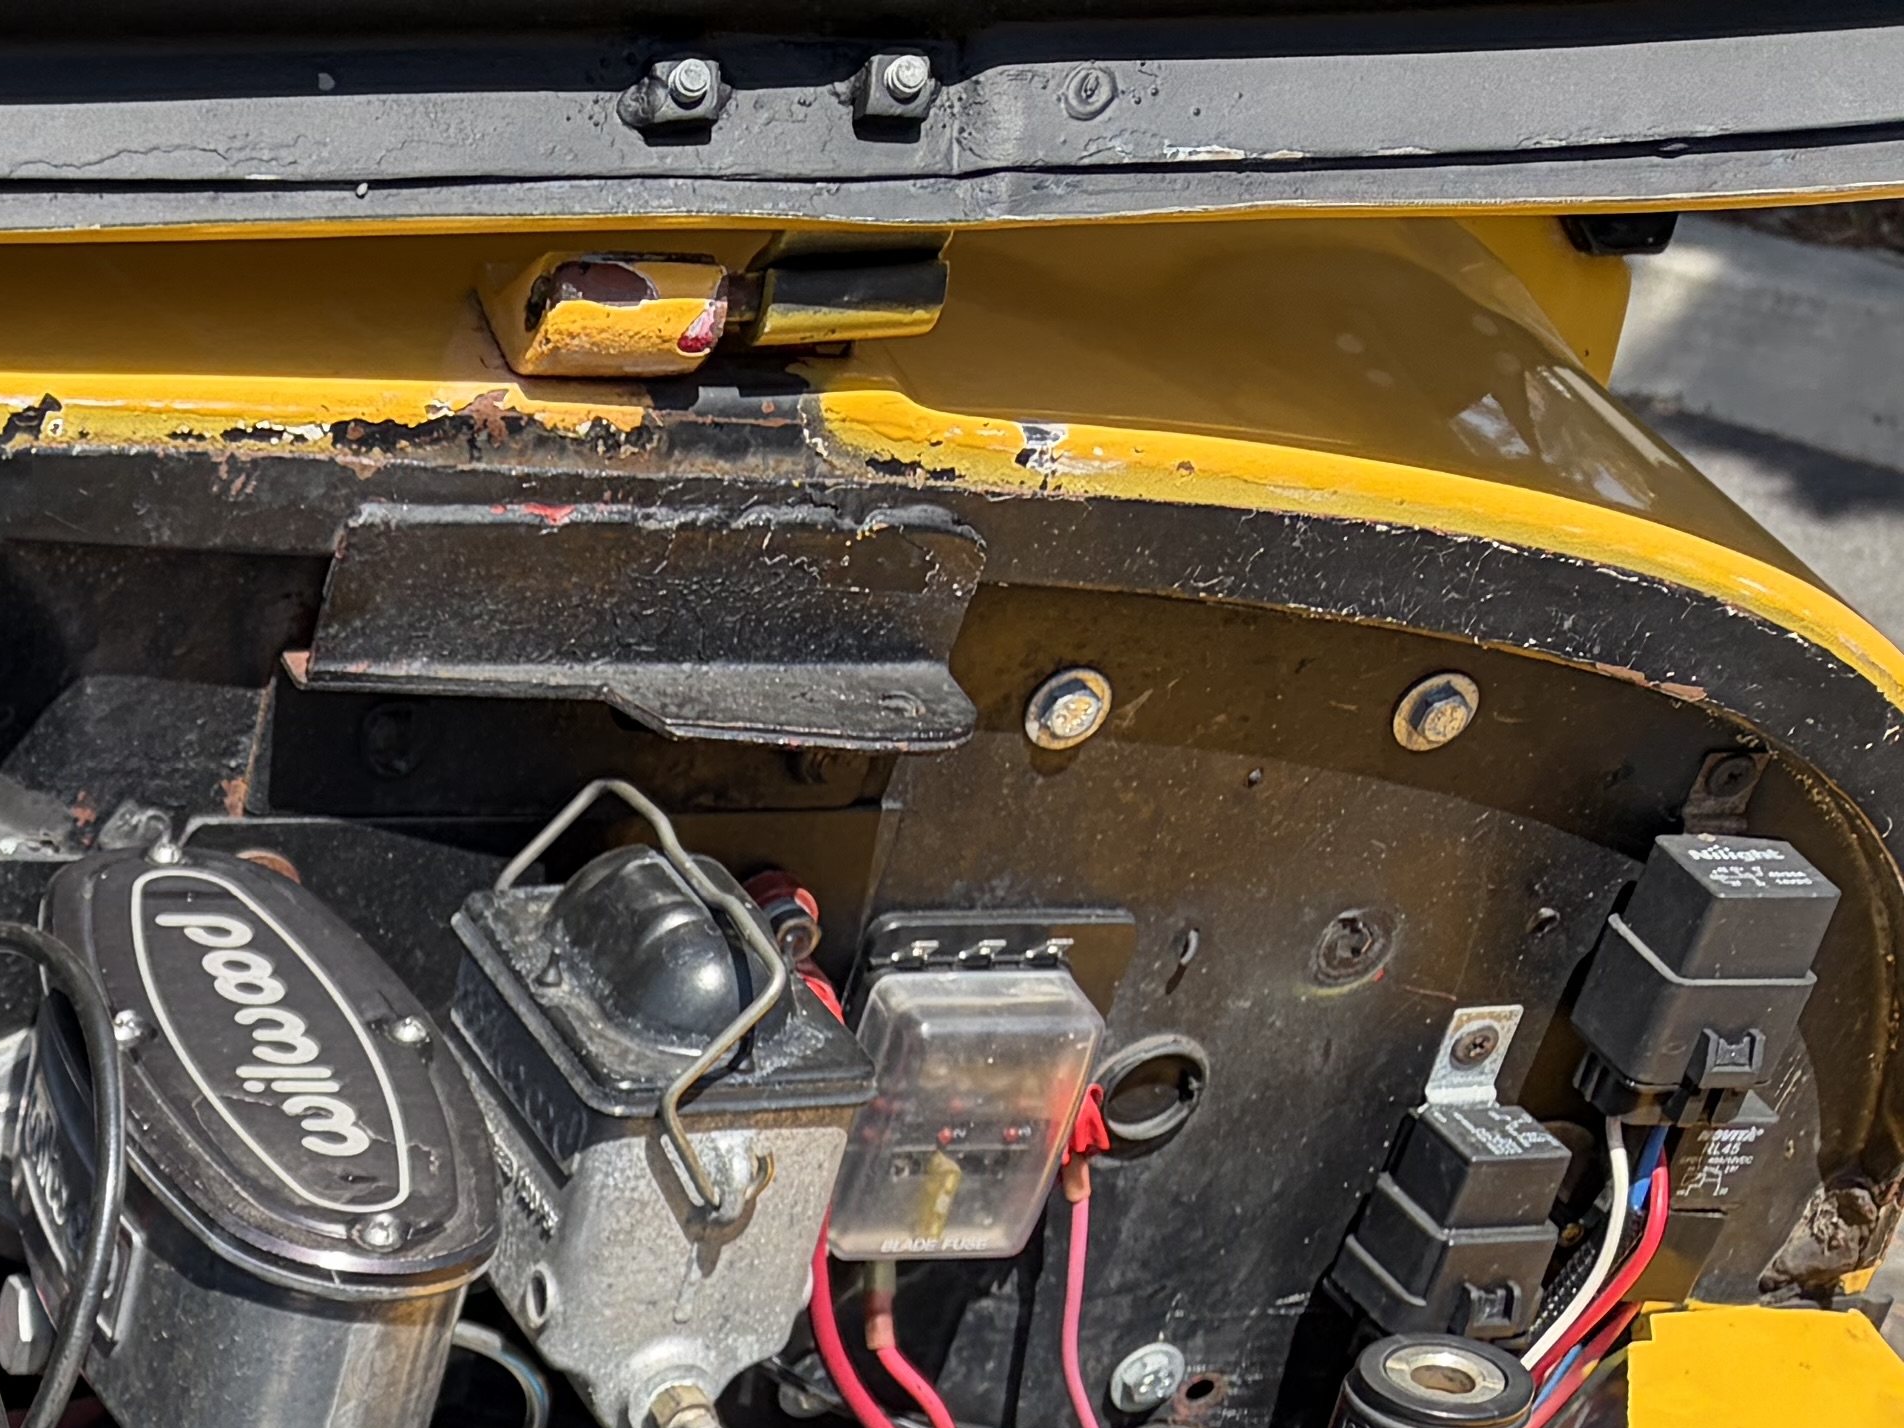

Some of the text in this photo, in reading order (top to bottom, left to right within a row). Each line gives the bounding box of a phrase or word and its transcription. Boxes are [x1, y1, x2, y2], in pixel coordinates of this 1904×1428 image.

[155, 914, 370, 1157] wilwood
[880, 1237, 989, 1253] BLADE FUSE
